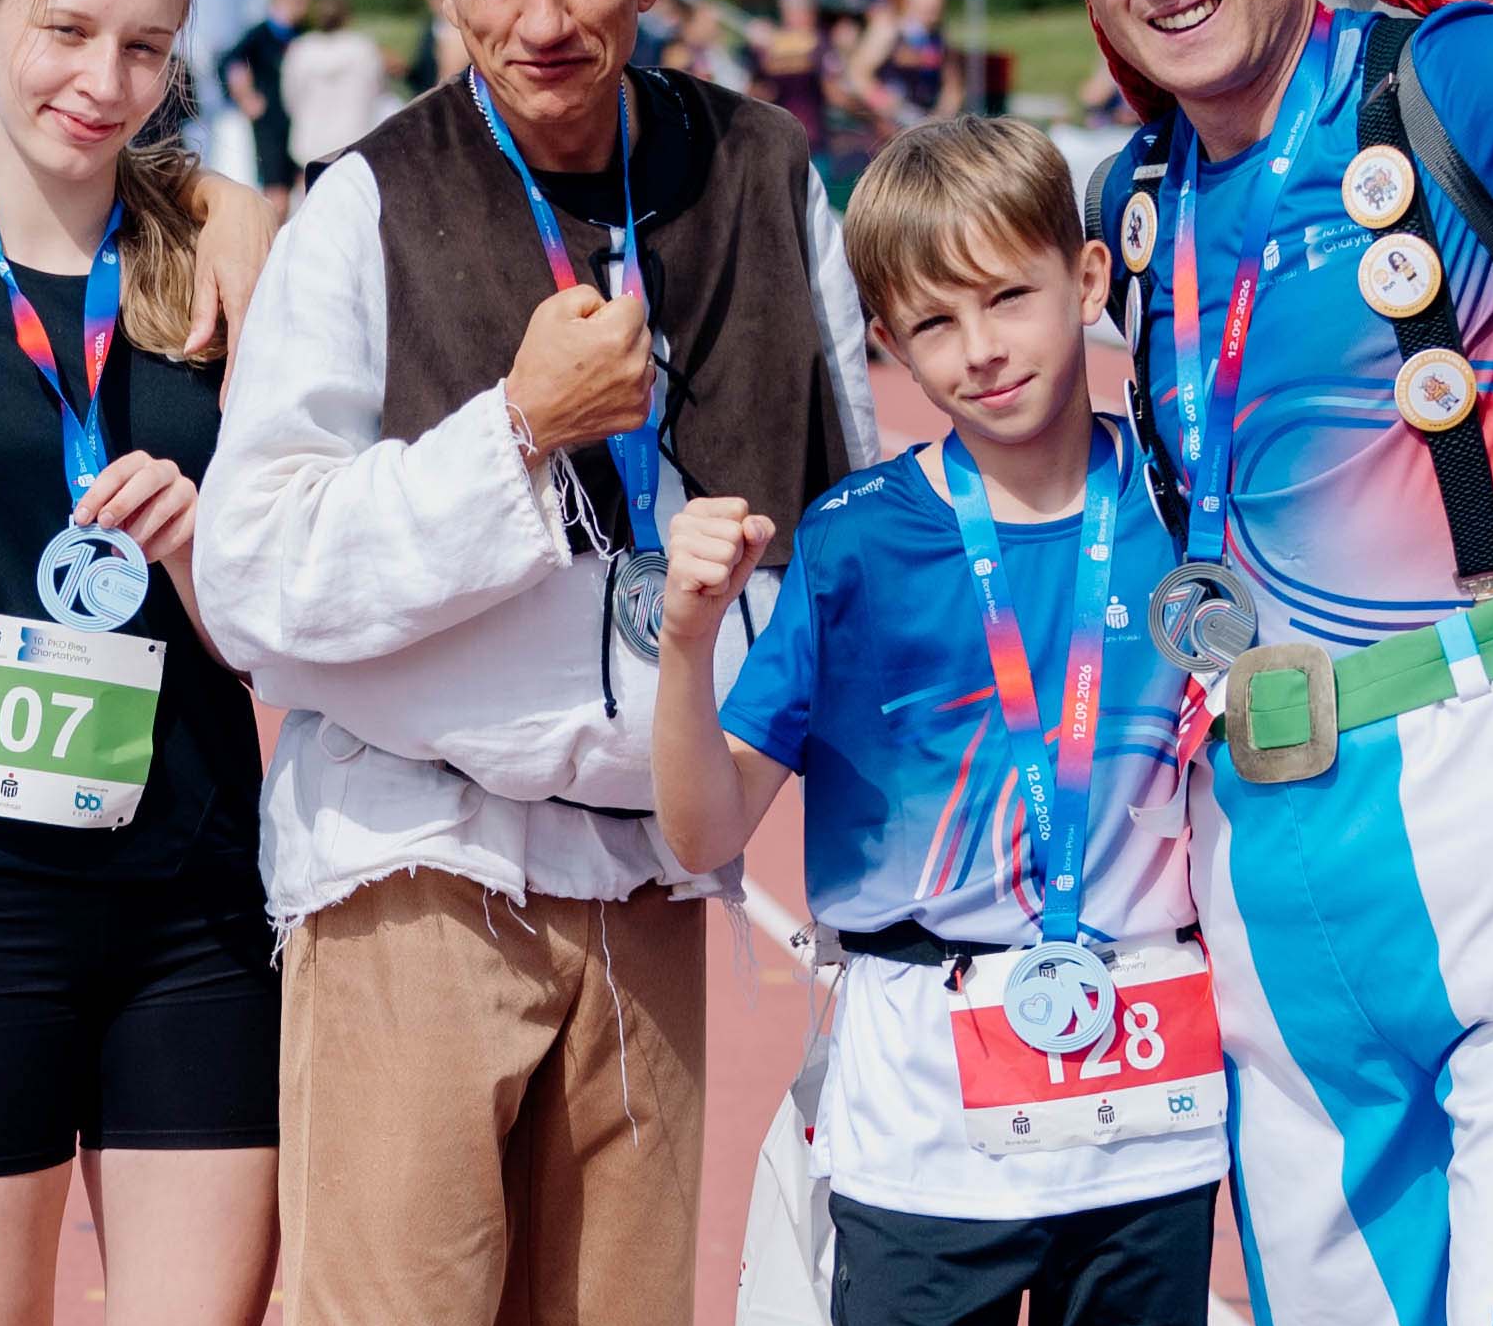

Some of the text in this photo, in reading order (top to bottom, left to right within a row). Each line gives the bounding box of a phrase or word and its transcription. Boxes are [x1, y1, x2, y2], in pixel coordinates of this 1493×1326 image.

[1228, 279, 1252, 359] 12.09.2026
[1183, 383, 1201, 462] 12.09.2026
[29, 646, 92, 665] Charytatywny
[47, 638, 66, 650] PKO
[68, 641, 88, 653] Bieg
[1072, 663, 1093, 742] 12.09.2026
[1024, 763, 1051, 842] 12.09.2026
